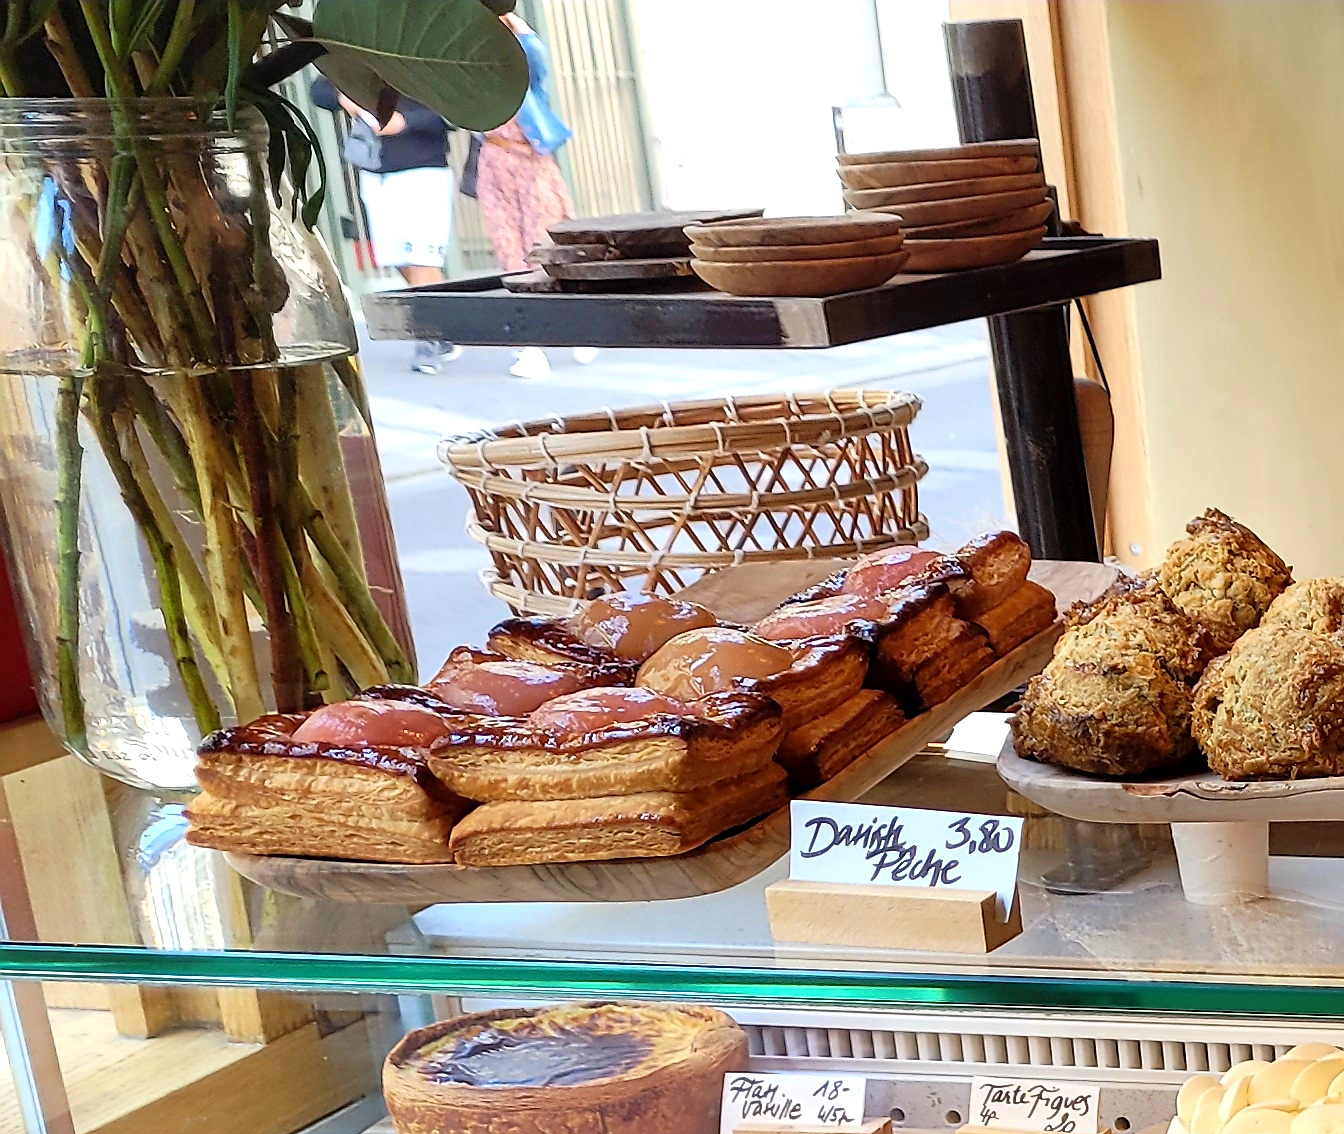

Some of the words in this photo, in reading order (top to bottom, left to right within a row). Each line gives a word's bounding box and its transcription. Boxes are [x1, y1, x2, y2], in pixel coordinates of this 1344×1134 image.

[800, 815, 908, 858] Danish
[945, 816, 1015, 855] 3,80
[730, 1077, 780, 1103] Flan
[979, 1083, 1030, 1105] Tarte
[1026, 1084, 1093, 1120] Figues
[741, 1093, 803, 1120] Vanille
